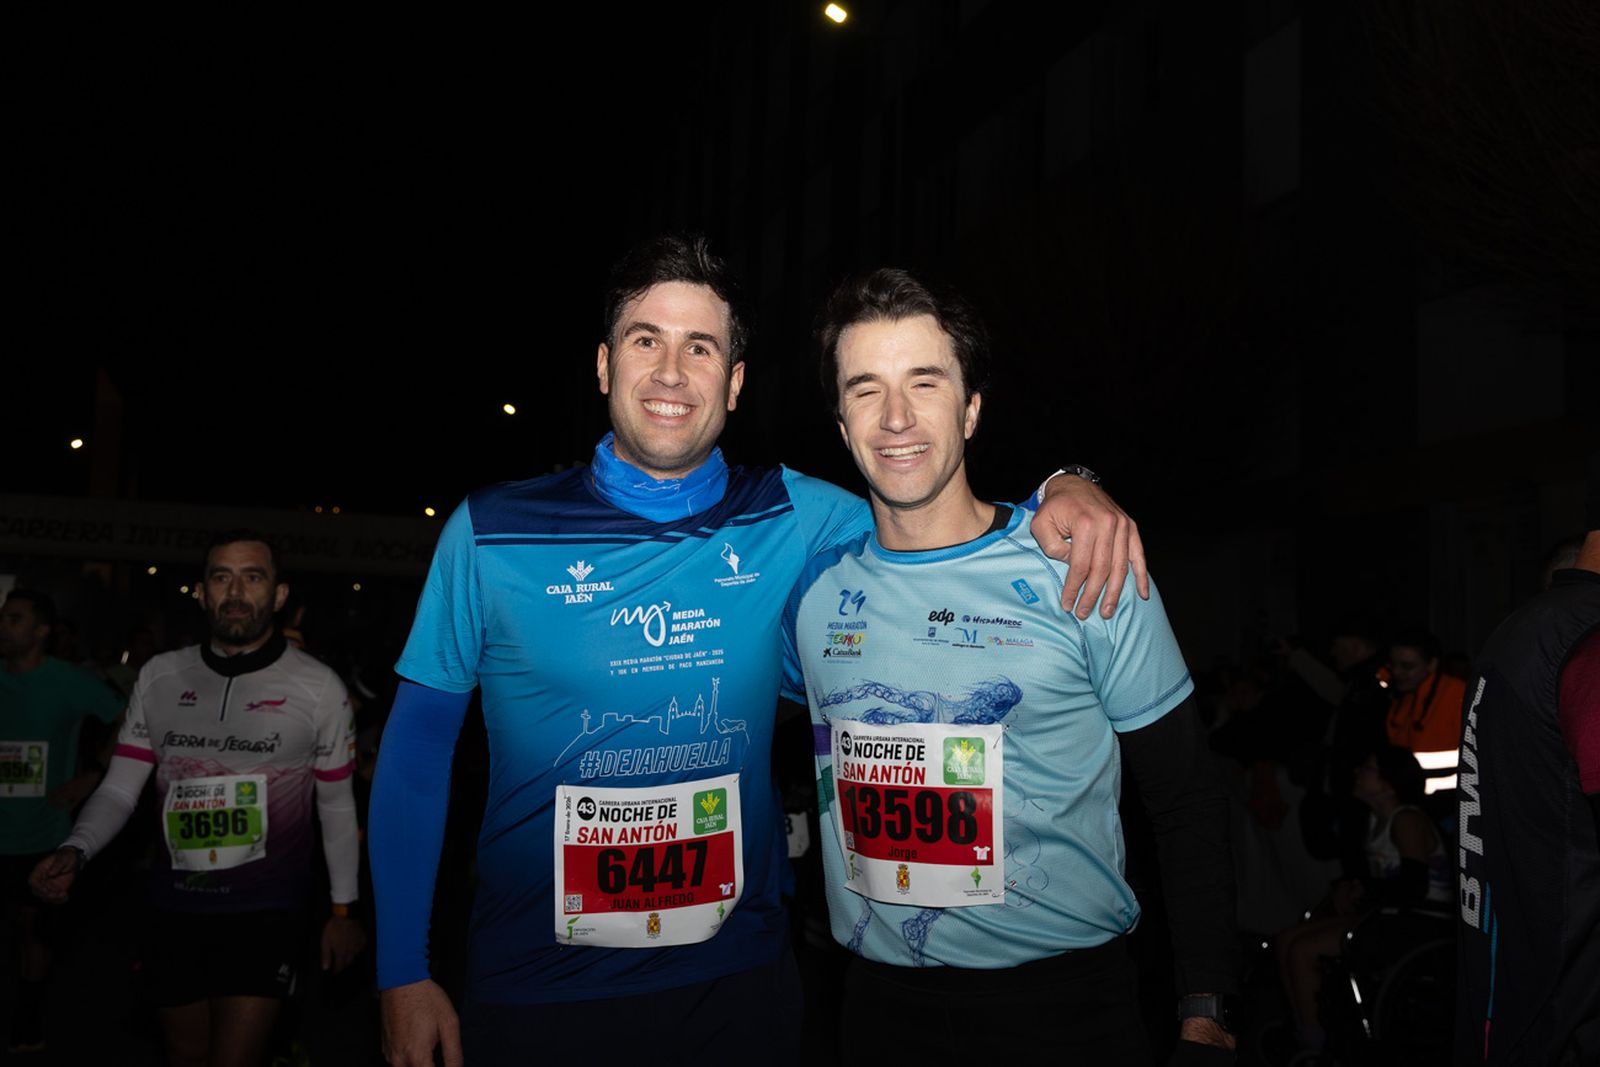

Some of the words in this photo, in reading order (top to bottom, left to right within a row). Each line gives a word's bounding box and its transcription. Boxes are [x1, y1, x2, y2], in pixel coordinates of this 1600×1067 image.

[546, 584, 573, 595] CAJA
[576, 581, 614, 593] RURAL
[565, 593, 593, 604] JAÉN
[838, 589, 867, 616] 29
[672, 608, 705, 620] MEDIA
[928, 608, 955, 626] edp
[671, 618, 720, 632] MARATÓN
[668, 634, 694, 645] JAÉN
[642, 665, 665, 673] MEMORIA
[218, 736, 275, 753] SEGURA
[854, 742, 902, 760] NOCHE
[906, 744, 925, 761] DE
[579, 738, 731, 778] #DEJAHUELLA
[843, 761, 866, 781] SAN
[869, 761, 926, 785] ANTÓN
[214, 787, 225, 797] DE
[174, 801, 190, 810] SAN
[577, 801, 595, 815] 43
[641, 797, 677, 805] INTERNACIONAL
[1458, 675, 1488, 930] BTWIN
[599, 806, 654, 823] NOCHE
[657, 803, 677, 820] DE
[844, 785, 978, 845] 13598
[180, 809, 248, 839] 3696
[577, 826, 614, 844] SAN
[617, 820, 678, 844] ANTÓN
[888, 846, 918, 860] Jorge
[598, 841, 708, 894] 6447
[609, 895, 641, 910] JUAN
[644, 892, 695, 908] ALFREDO
